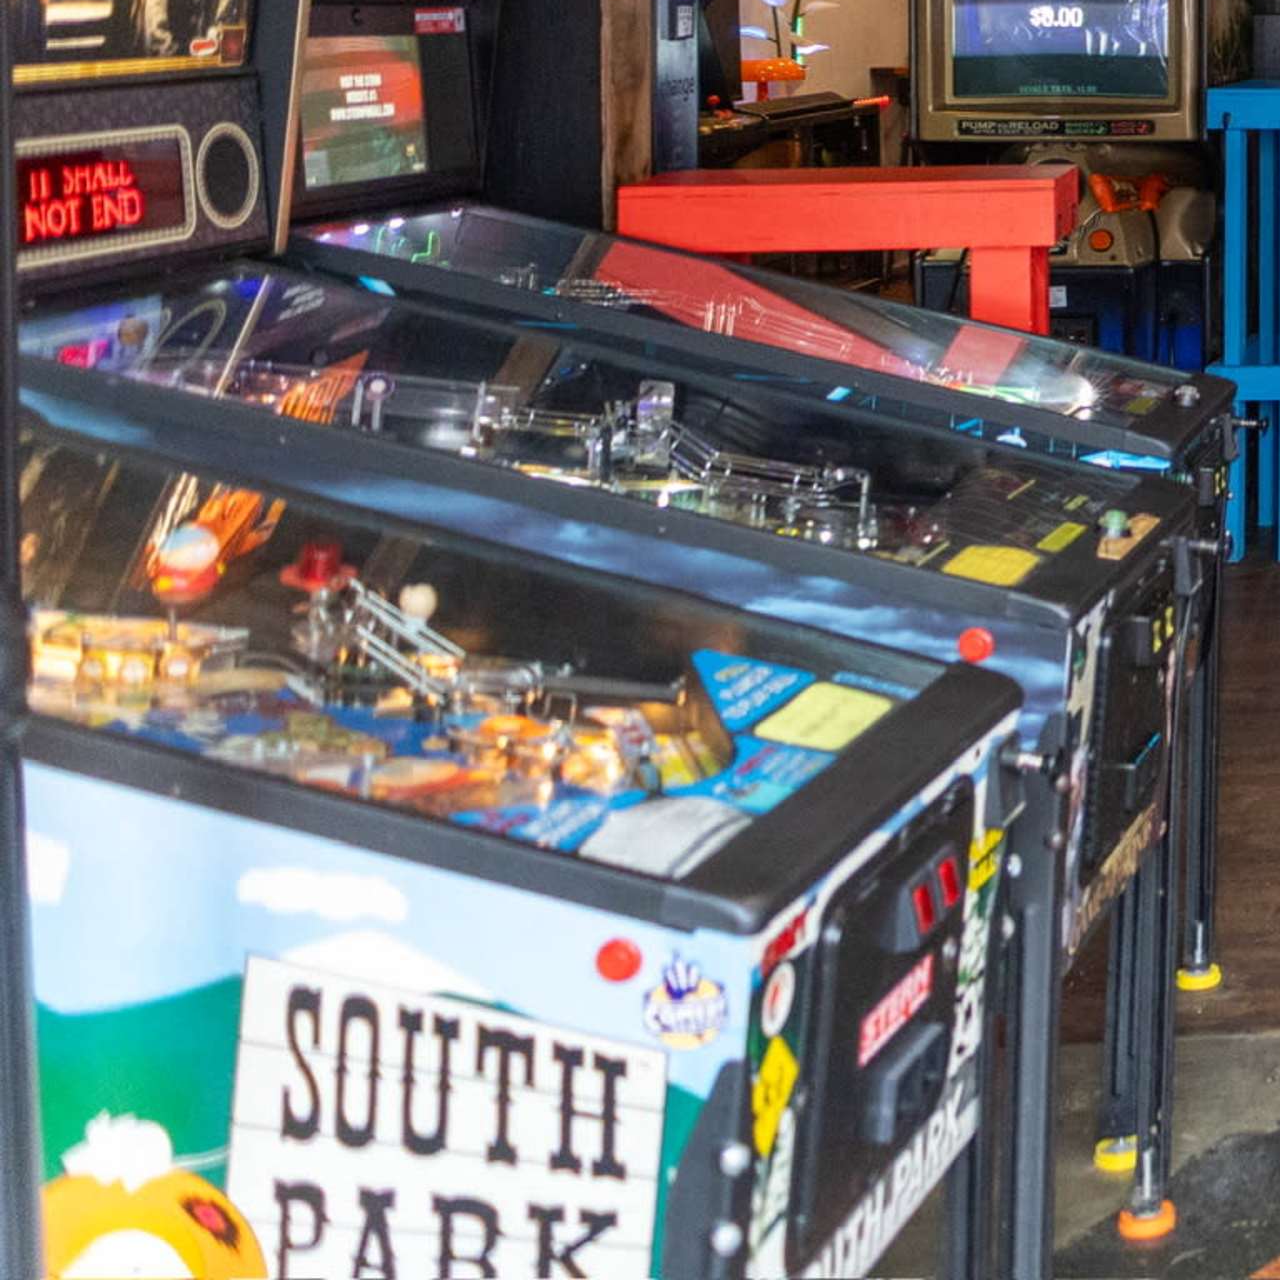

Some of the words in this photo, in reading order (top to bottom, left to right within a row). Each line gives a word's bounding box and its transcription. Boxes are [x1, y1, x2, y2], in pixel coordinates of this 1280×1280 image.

[25, 197, 81, 243] NOT
[91, 188, 142, 232] END
[62, 160, 134, 196] SHALL
[277, 984, 629, 1181] SOUTH
[272, 1176, 620, 1280] PARK
